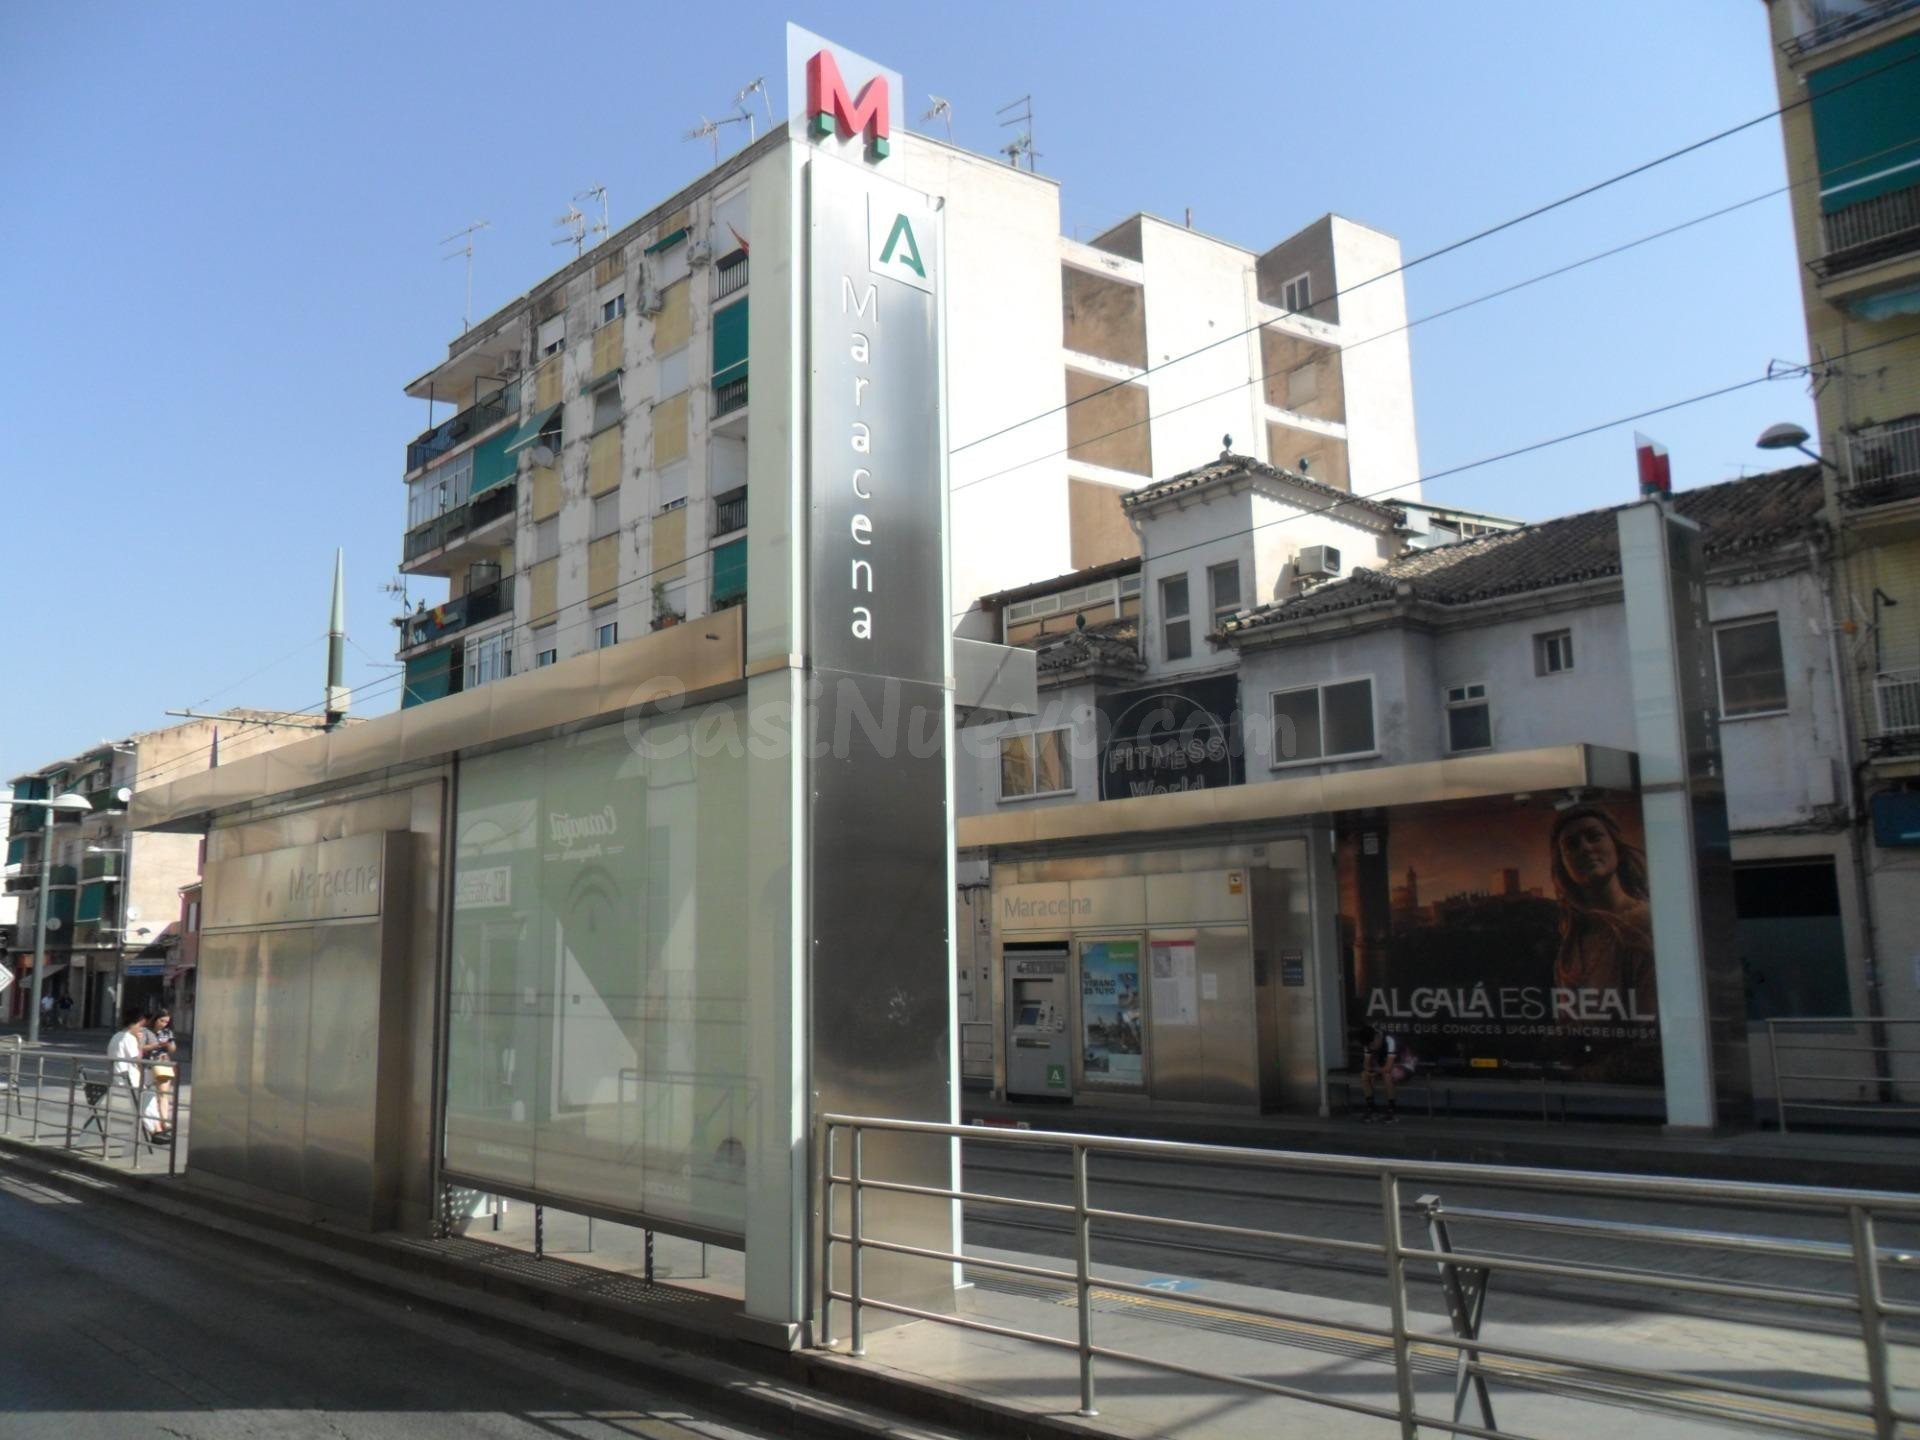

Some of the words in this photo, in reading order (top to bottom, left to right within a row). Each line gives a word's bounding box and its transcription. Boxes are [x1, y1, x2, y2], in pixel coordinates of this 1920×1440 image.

[841, 275, 879, 641] Maracena
[1109, 735, 1226, 774] FITNESS
[288, 864, 378, 902] Maracena
[1004, 896, 1092, 918] Maracena
[1500, 987, 1545, 1019] ES
[1551, 988, 1656, 1021] REAL
[1414, 1023, 1438, 1034] QUE
[1442, 1023, 1502, 1035] CONOCES
